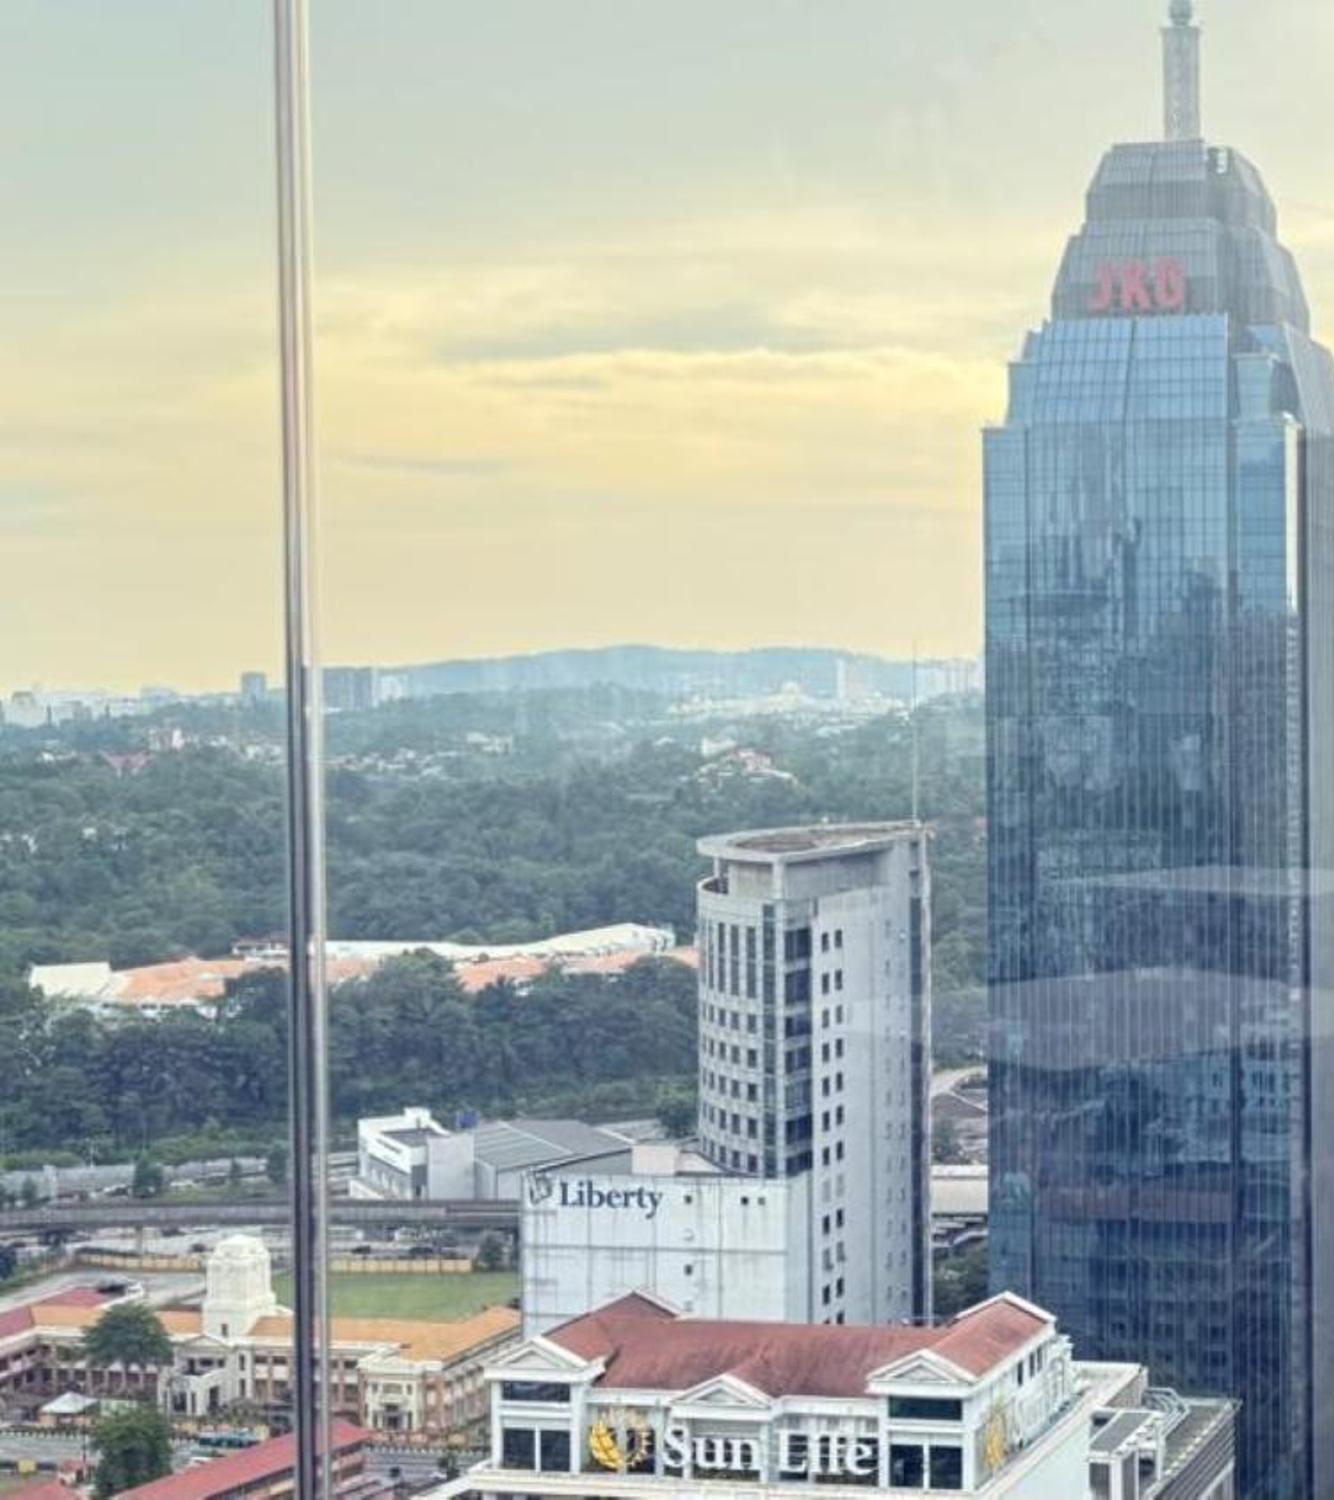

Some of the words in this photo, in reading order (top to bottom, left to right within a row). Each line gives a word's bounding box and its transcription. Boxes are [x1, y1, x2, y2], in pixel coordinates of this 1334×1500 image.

[560, 1179, 663, 1219] Liberty
[663, 1421, 761, 1472] Sun
[778, 1428, 878, 1476] Life
